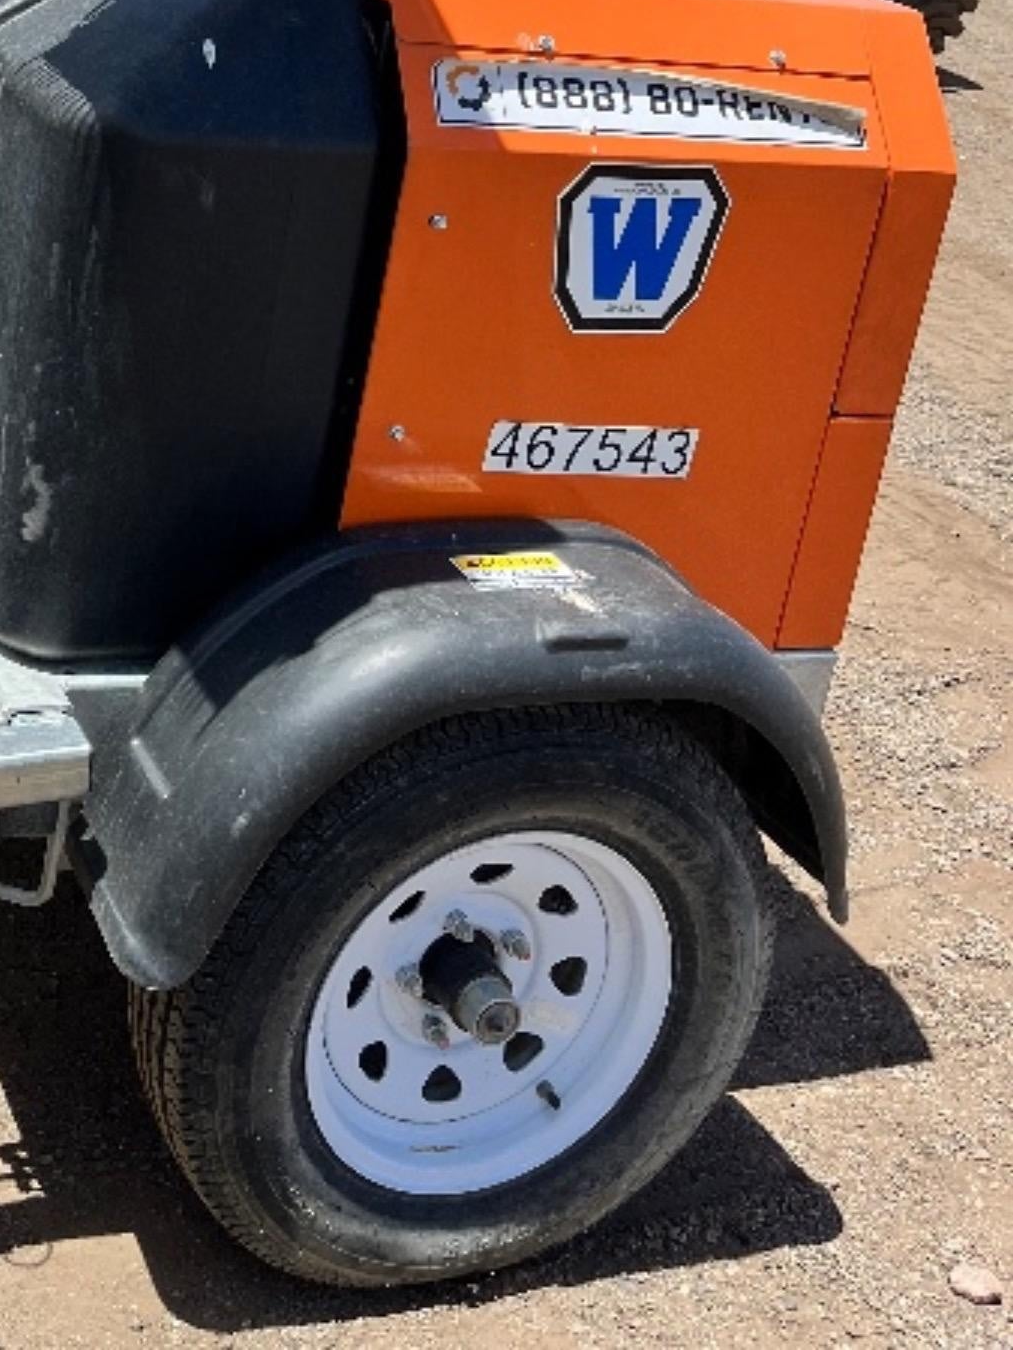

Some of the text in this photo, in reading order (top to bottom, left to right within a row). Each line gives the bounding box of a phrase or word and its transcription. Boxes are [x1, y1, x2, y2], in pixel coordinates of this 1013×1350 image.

[517, 71, 632, 115] (888)
[587, 195, 703, 301] W
[490, 422, 691, 475] 467543
